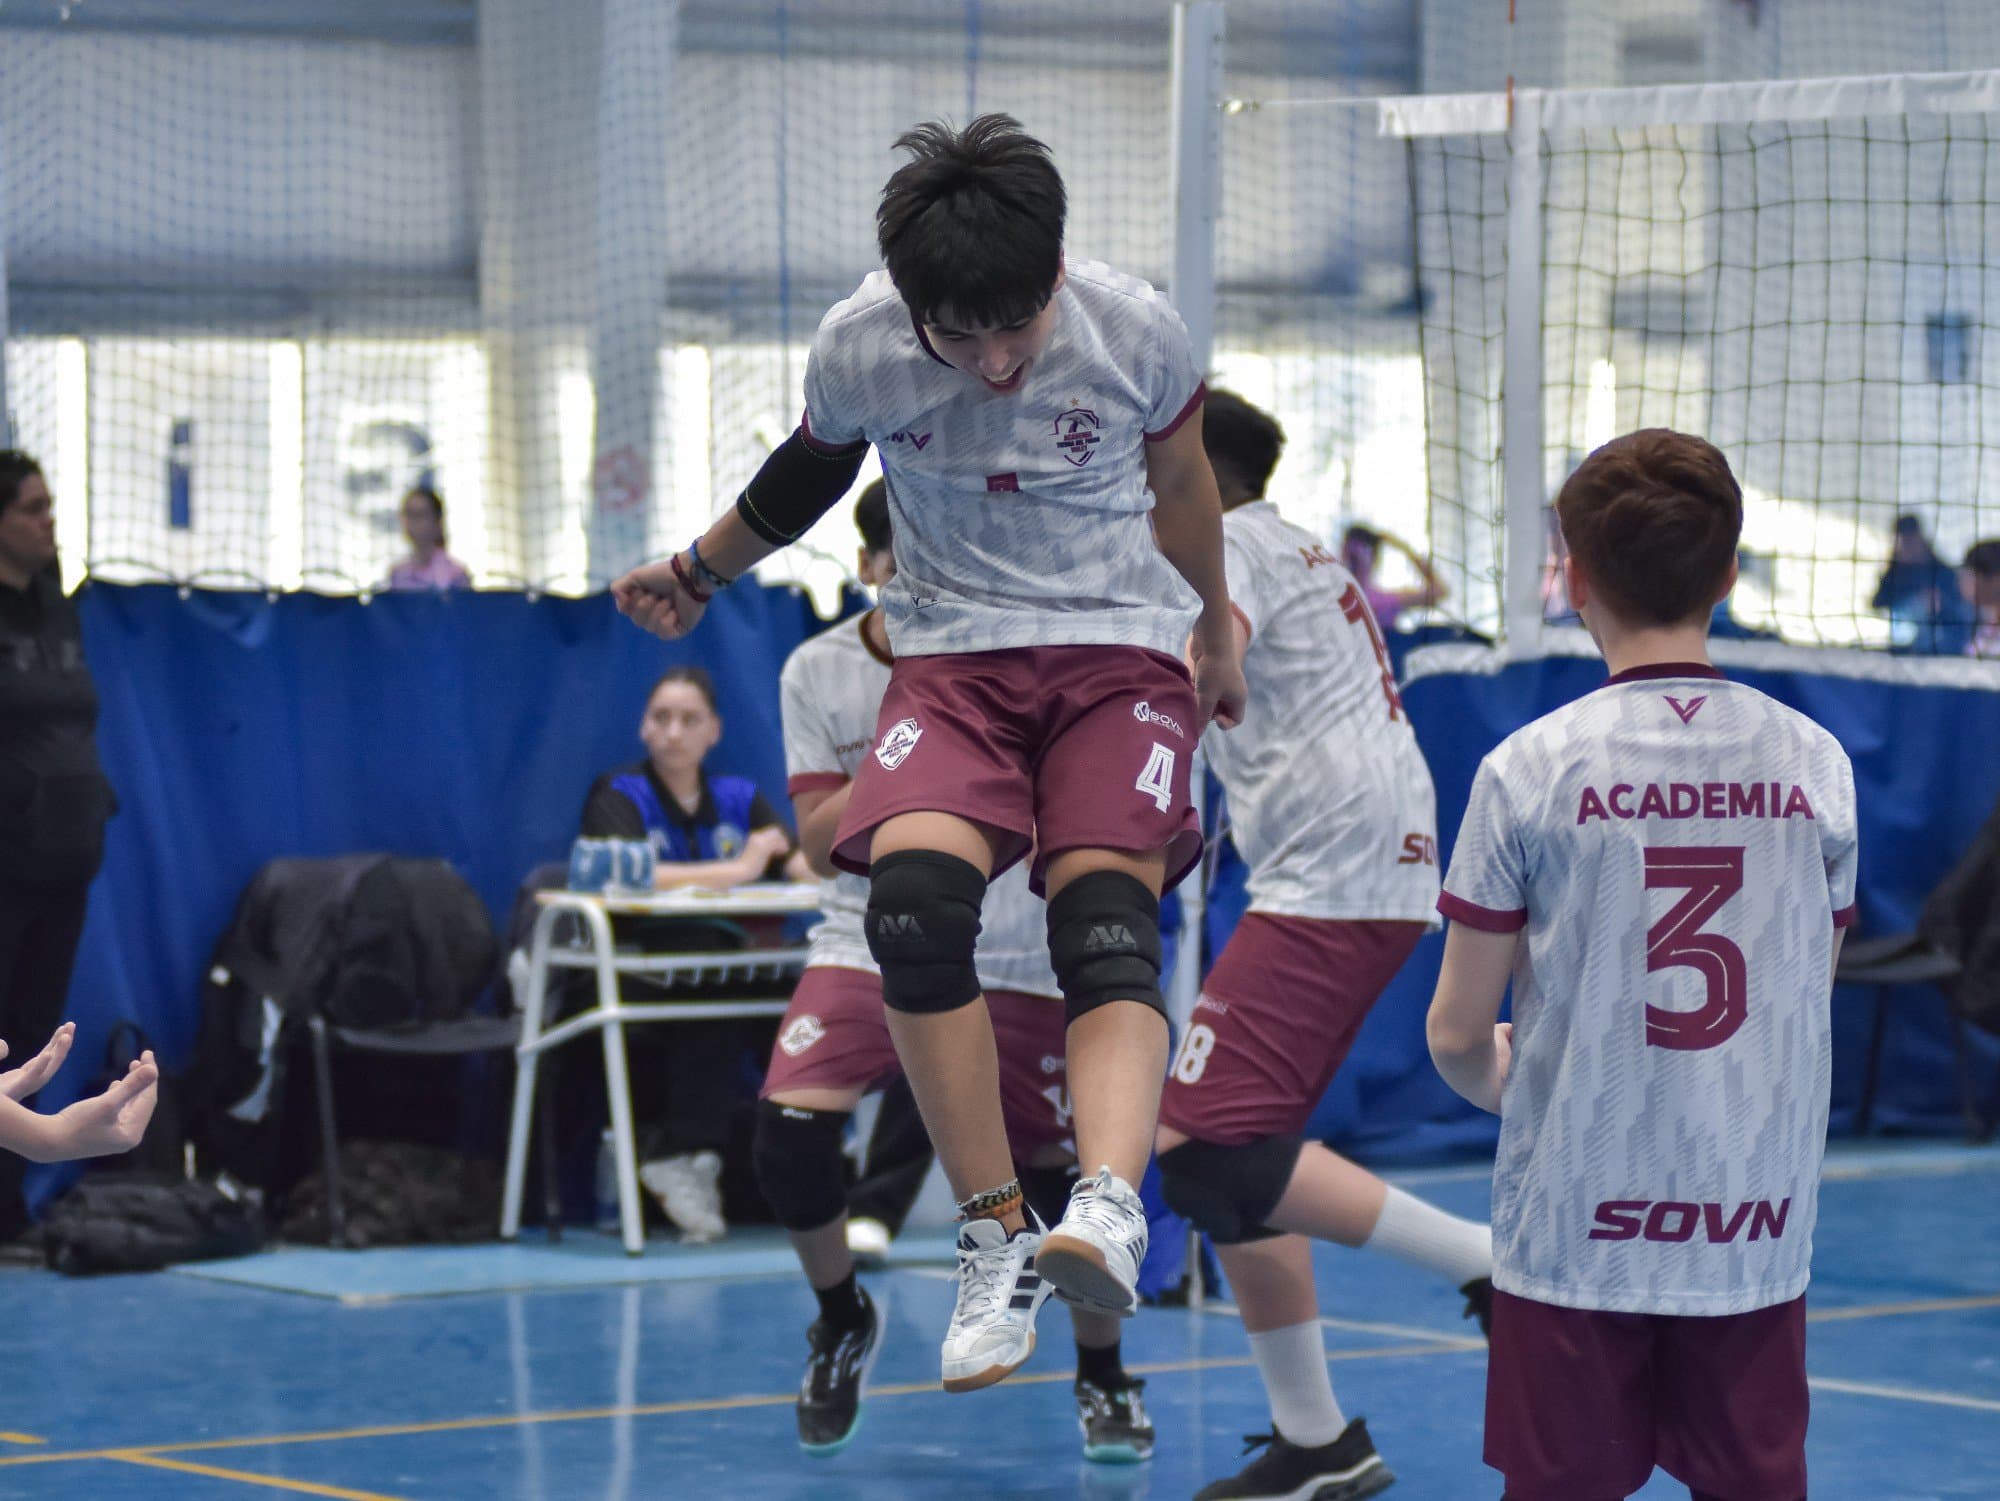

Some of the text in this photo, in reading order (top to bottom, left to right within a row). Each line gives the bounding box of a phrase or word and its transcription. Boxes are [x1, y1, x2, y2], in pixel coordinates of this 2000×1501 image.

[1136, 742, 1175, 813] 4
[1577, 783, 1814, 824] ACADEMIA
[1643, 846, 1748, 1051] 3
[1588, 1198, 1792, 1244] SOVN
